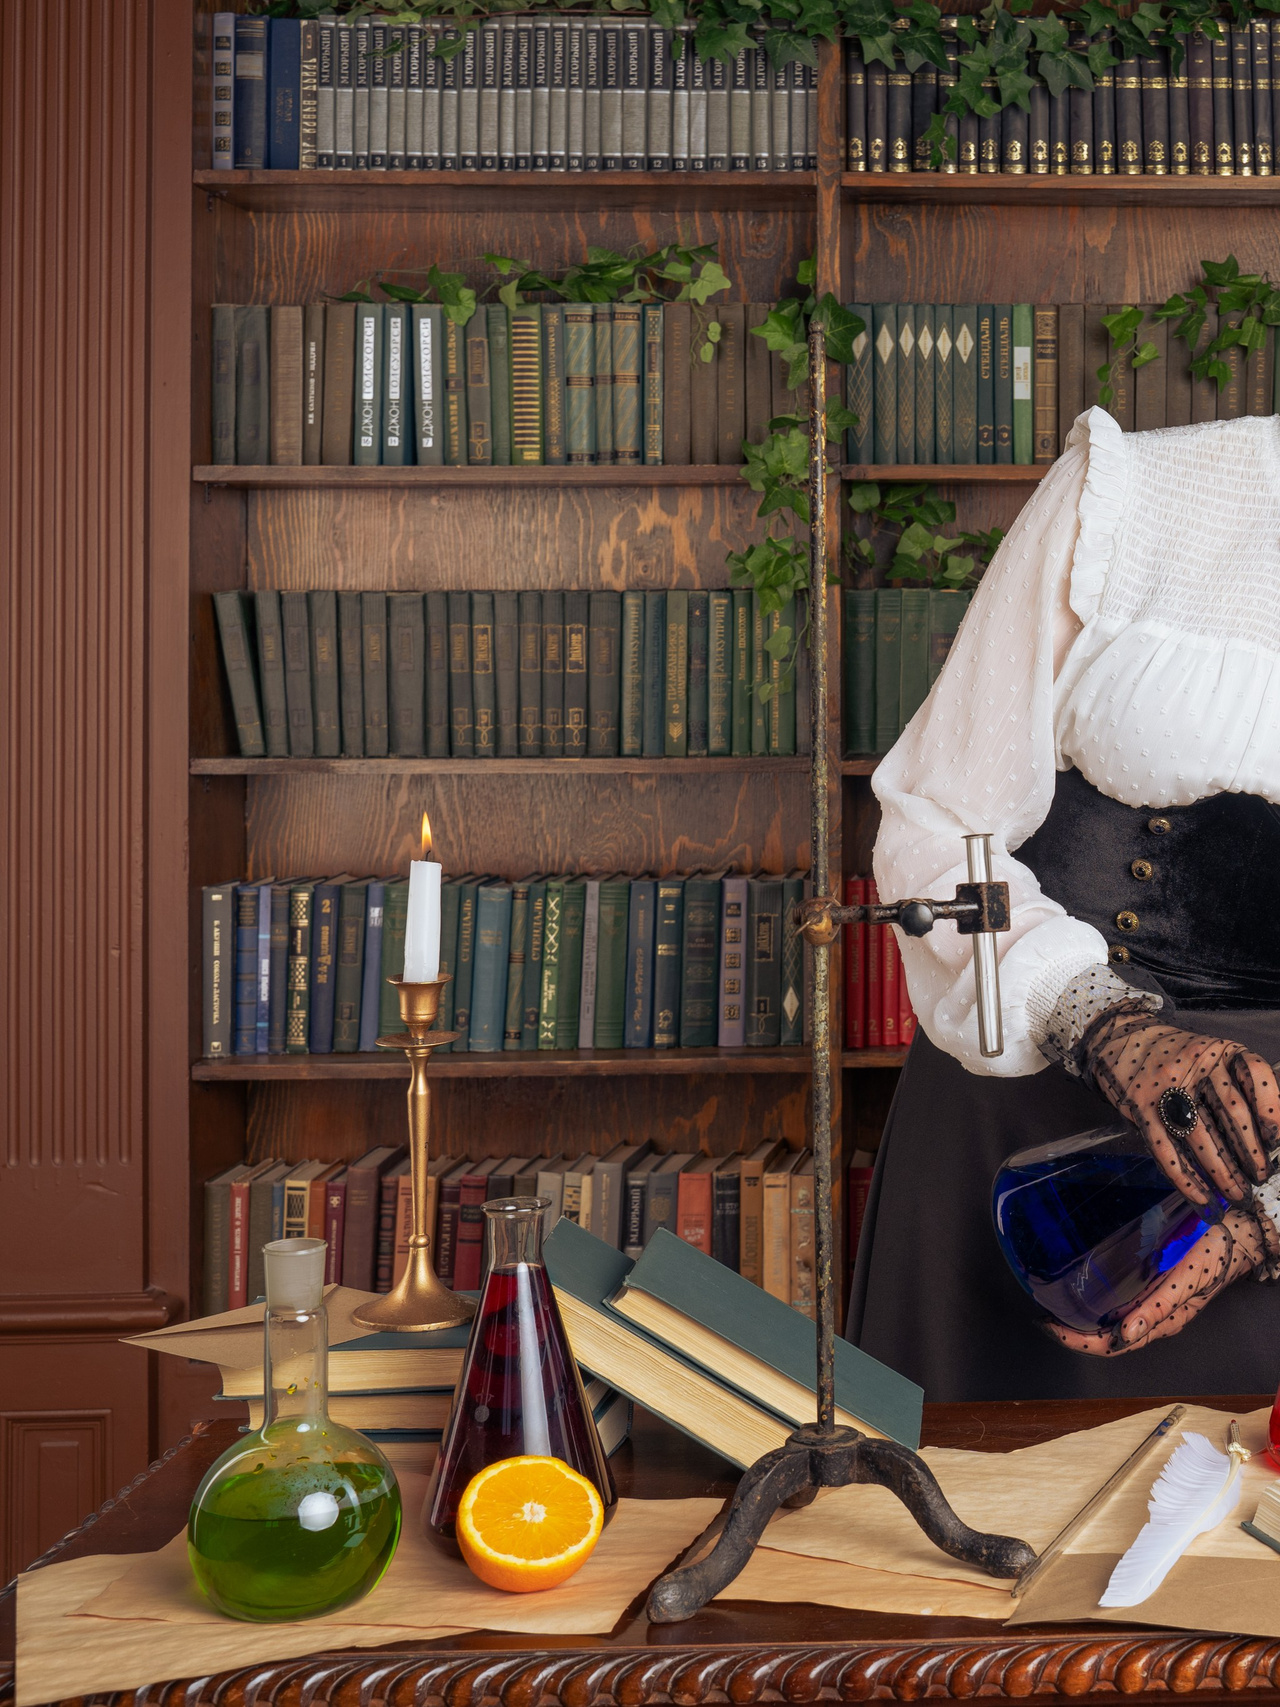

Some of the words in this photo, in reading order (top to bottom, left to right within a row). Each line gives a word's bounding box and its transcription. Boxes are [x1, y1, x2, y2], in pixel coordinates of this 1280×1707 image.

[321, 29, 331, 84] М.ГОРЬКИЙ
[340, 31, 350, 84] М.ГОРЬКИЙ
[373, 30, 383, 84] М.ГОРКИЙ
[464, 31, 474, 85] М.ГОРЬКИЙ
[485, 32, 494, 85] М.ГОРЬКИЙ
[503, 32, 512, 86] М.ГОРЬКИЙ
[519, 32, 528, 85] М.ГОРЬКИЙ
[536, 31, 545, 84] М.ГОРЬКИЙ
[553, 31, 562, 84] М.ГОРЬКИЙ
[570, 31, 580, 85] М.ГОРЬКИЙ
[588, 33, 597, 86] М.ГОРЬКИЙ
[606, 32, 616, 86] М.ГОРЬКИЙ
[628, 32, 638, 86] М.ГОРЬКИЙ
[653, 32, 663, 86] М.ГОРЬКИЙ
[363, 319, 374, 394] ГОЛСУОРСИ
[390, 319, 401, 395] ГОЛСУОРСИ
[421, 320, 432, 395] ГОЛСУОРСИ
[447, 318, 458, 374] ШОЛОХО
[982, 318, 991, 379] СТЕНДАЛЬ
[1000, 317, 1009, 379] СТЕНДАЛЬ
[1117, 348, 1127, 379] ТОЛС
[362, 400, 373, 436] ДЖОН
[388, 399, 400, 436] ДЖОН
[422, 400, 434, 436] ДЖОН
[1228, 387, 1237, 412] ЛЕВ
[1256, 388, 1265, 413] ЛЕВ
[716, 606, 726, 671] А.И.КУПРИН
[738, 607, 746, 649] ШОЛОХОВ
[668, 623, 677, 700] П.И.МЕЛЬНИКОВ
[738, 651, 746, 681] Михаил
[672, 704, 680, 713] 2
[322, 899, 330, 913] 2
[461, 899, 472, 962] СТЕНДАЛЬ
[531, 898, 543, 961] СТЕНДАЛЬ
[853, 1019, 858, 1031] 1
[869, 1019, 877, 1031] 2
[886, 1018, 894, 1030] 3
[904, 1018, 912, 1028] 4
[630, 1188, 641, 1243] М.ГОРЬКИЙ
[440, 1213, 451, 1276] И.СТАЛИН
